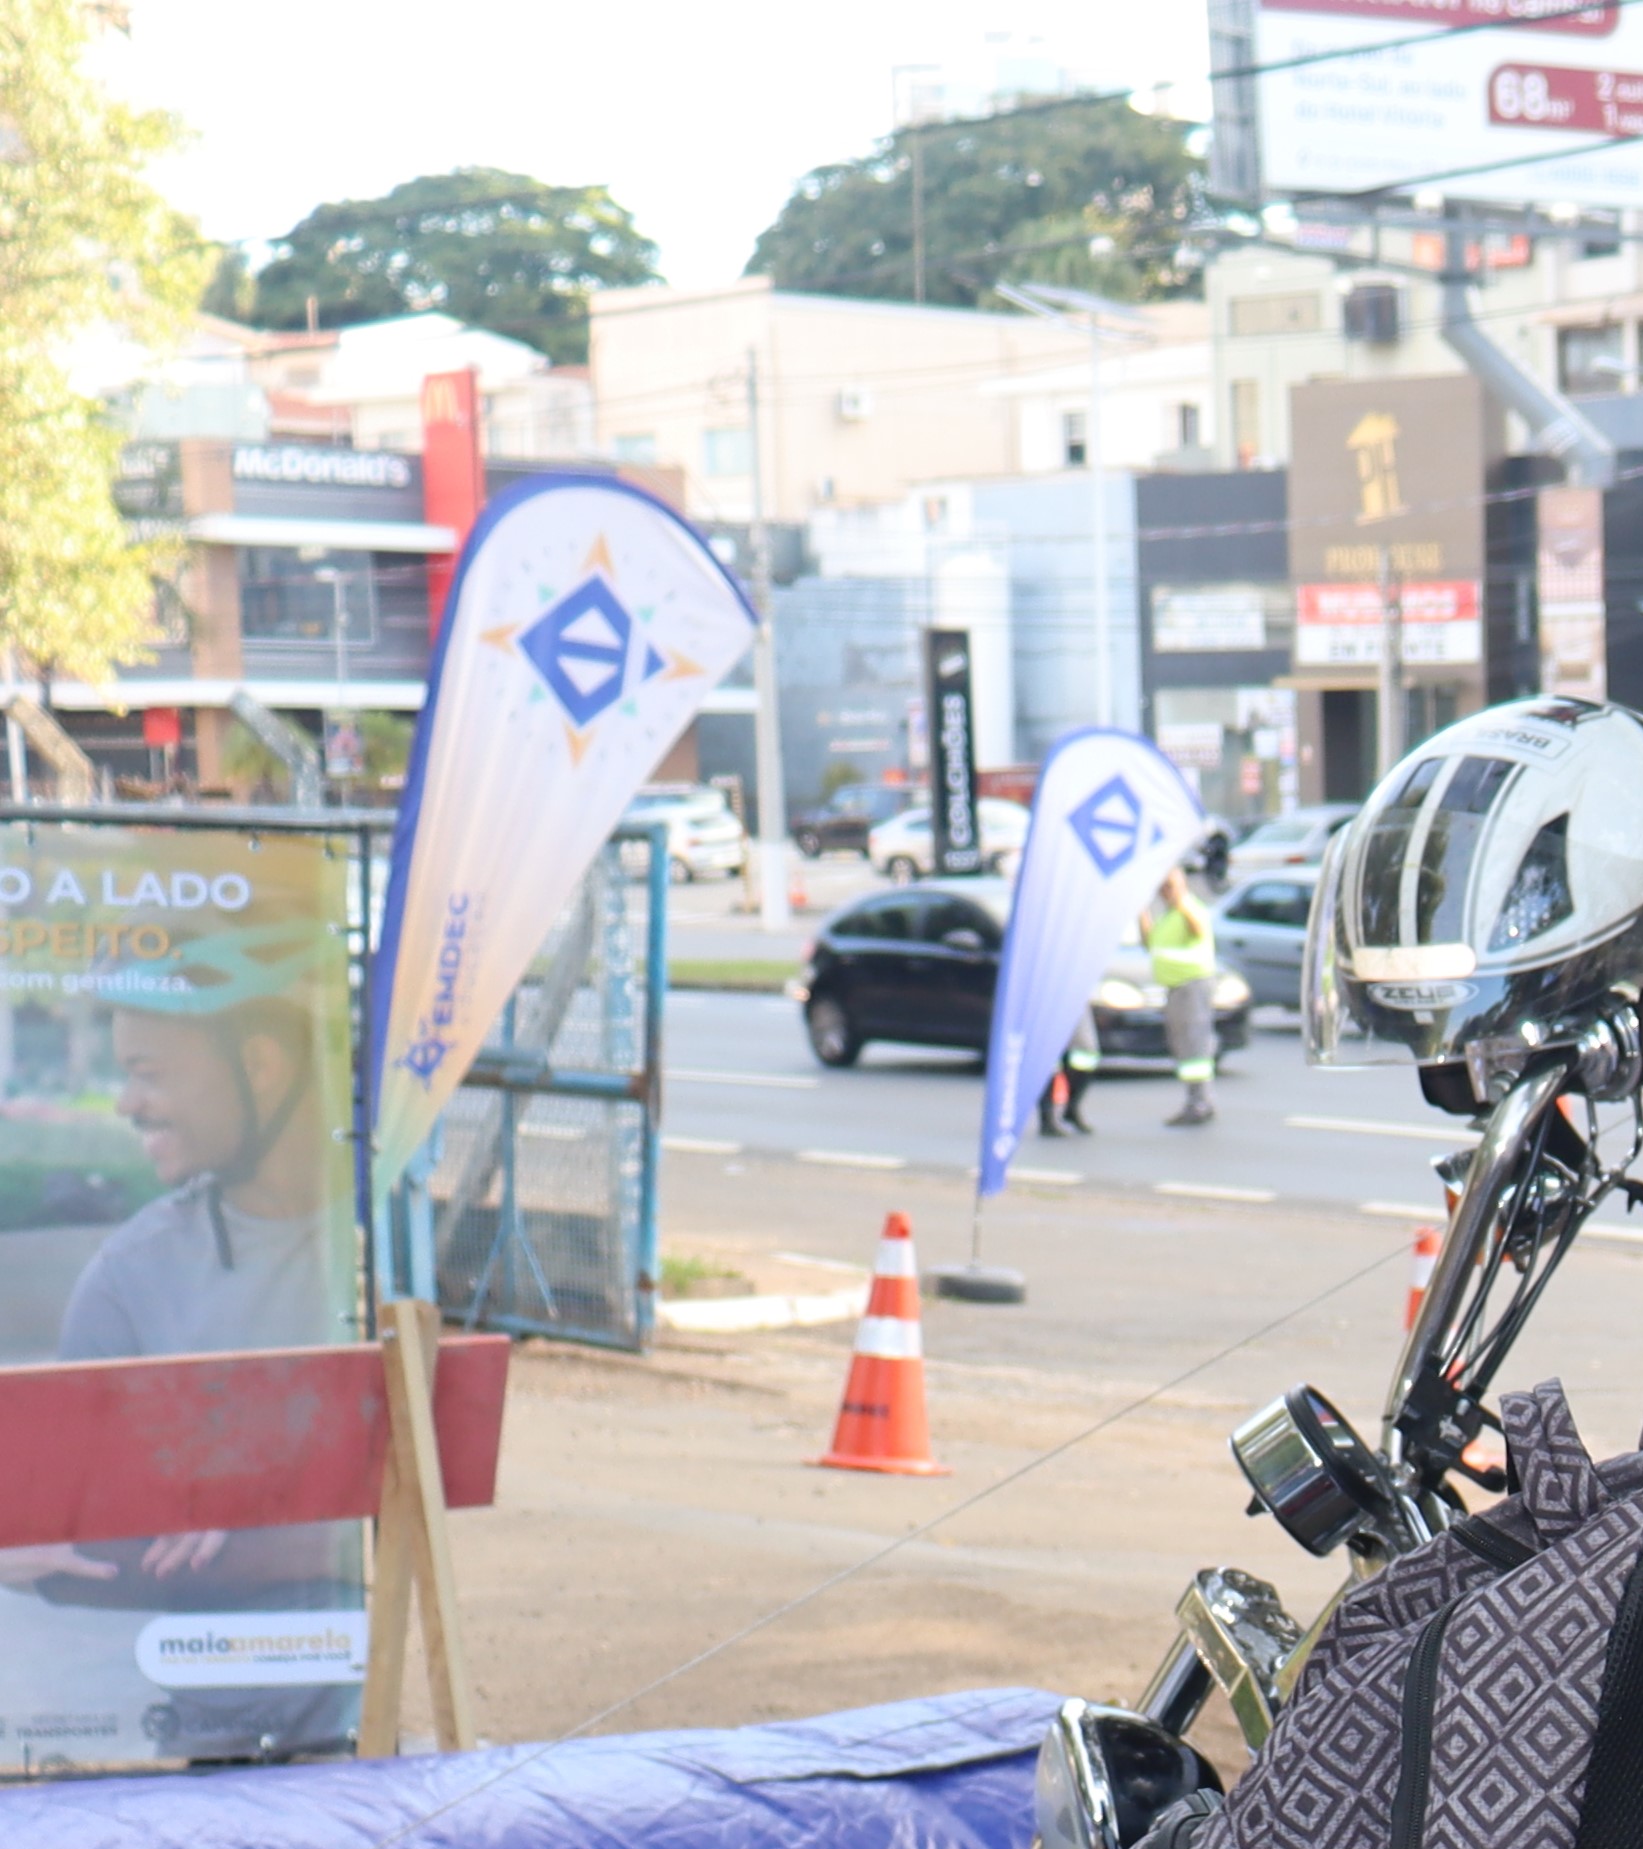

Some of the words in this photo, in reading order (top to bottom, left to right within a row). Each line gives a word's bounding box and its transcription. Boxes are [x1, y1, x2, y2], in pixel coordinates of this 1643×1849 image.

[1494, 69, 1547, 118] 68
[233, 446, 411, 487] McDonald's
[46, 868, 87, 905] A
[102, 870, 251, 912] LADO
[433, 891, 469, 1027] EMDEC
